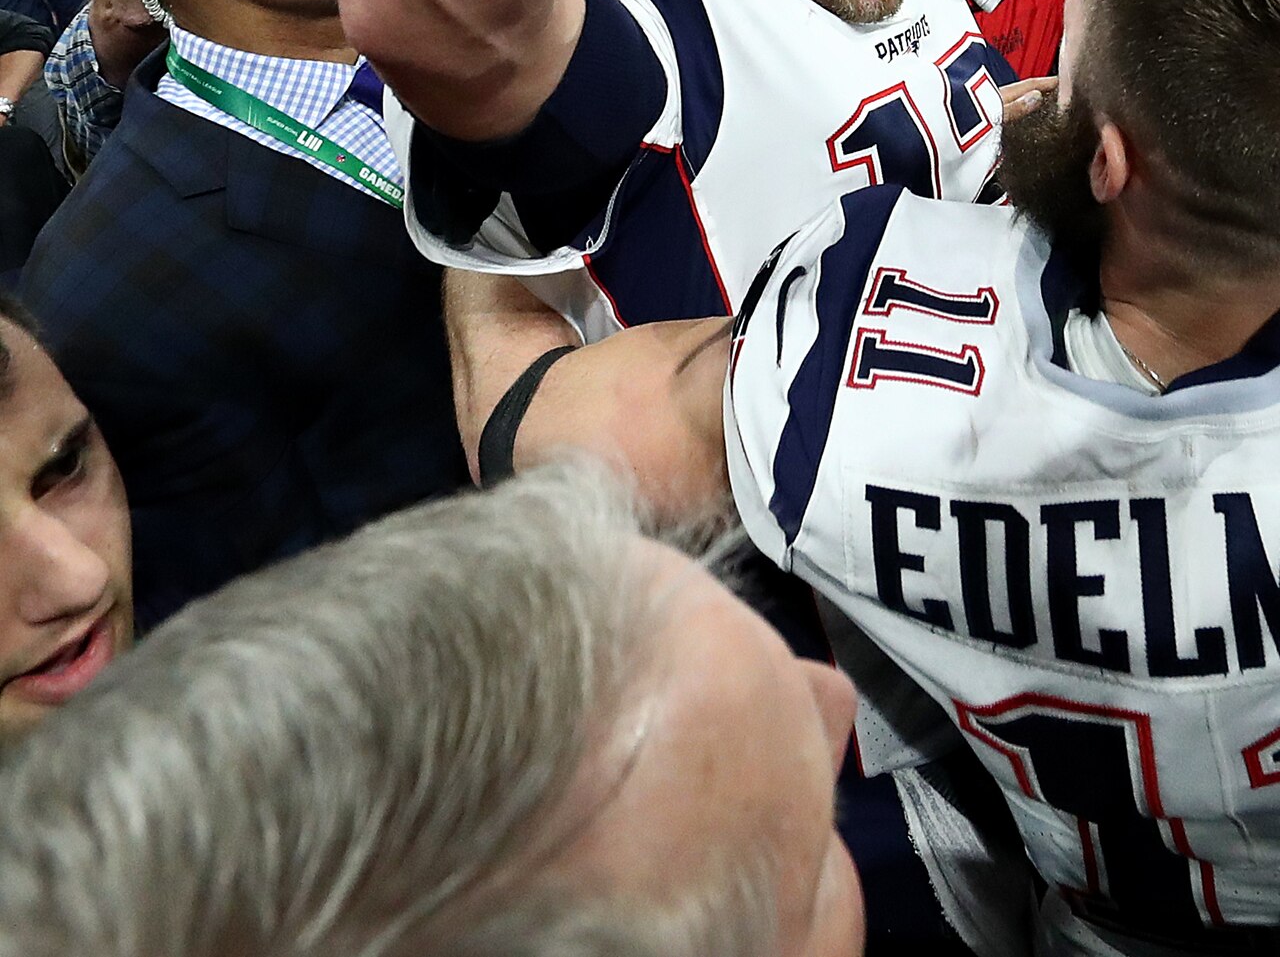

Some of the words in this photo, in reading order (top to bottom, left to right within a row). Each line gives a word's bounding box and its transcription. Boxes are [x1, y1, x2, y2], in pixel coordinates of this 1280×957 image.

[875, 14, 931, 63] PATRIOTS
[296, 130, 324, 152] LIII
[846, 267, 1000, 397] 11
